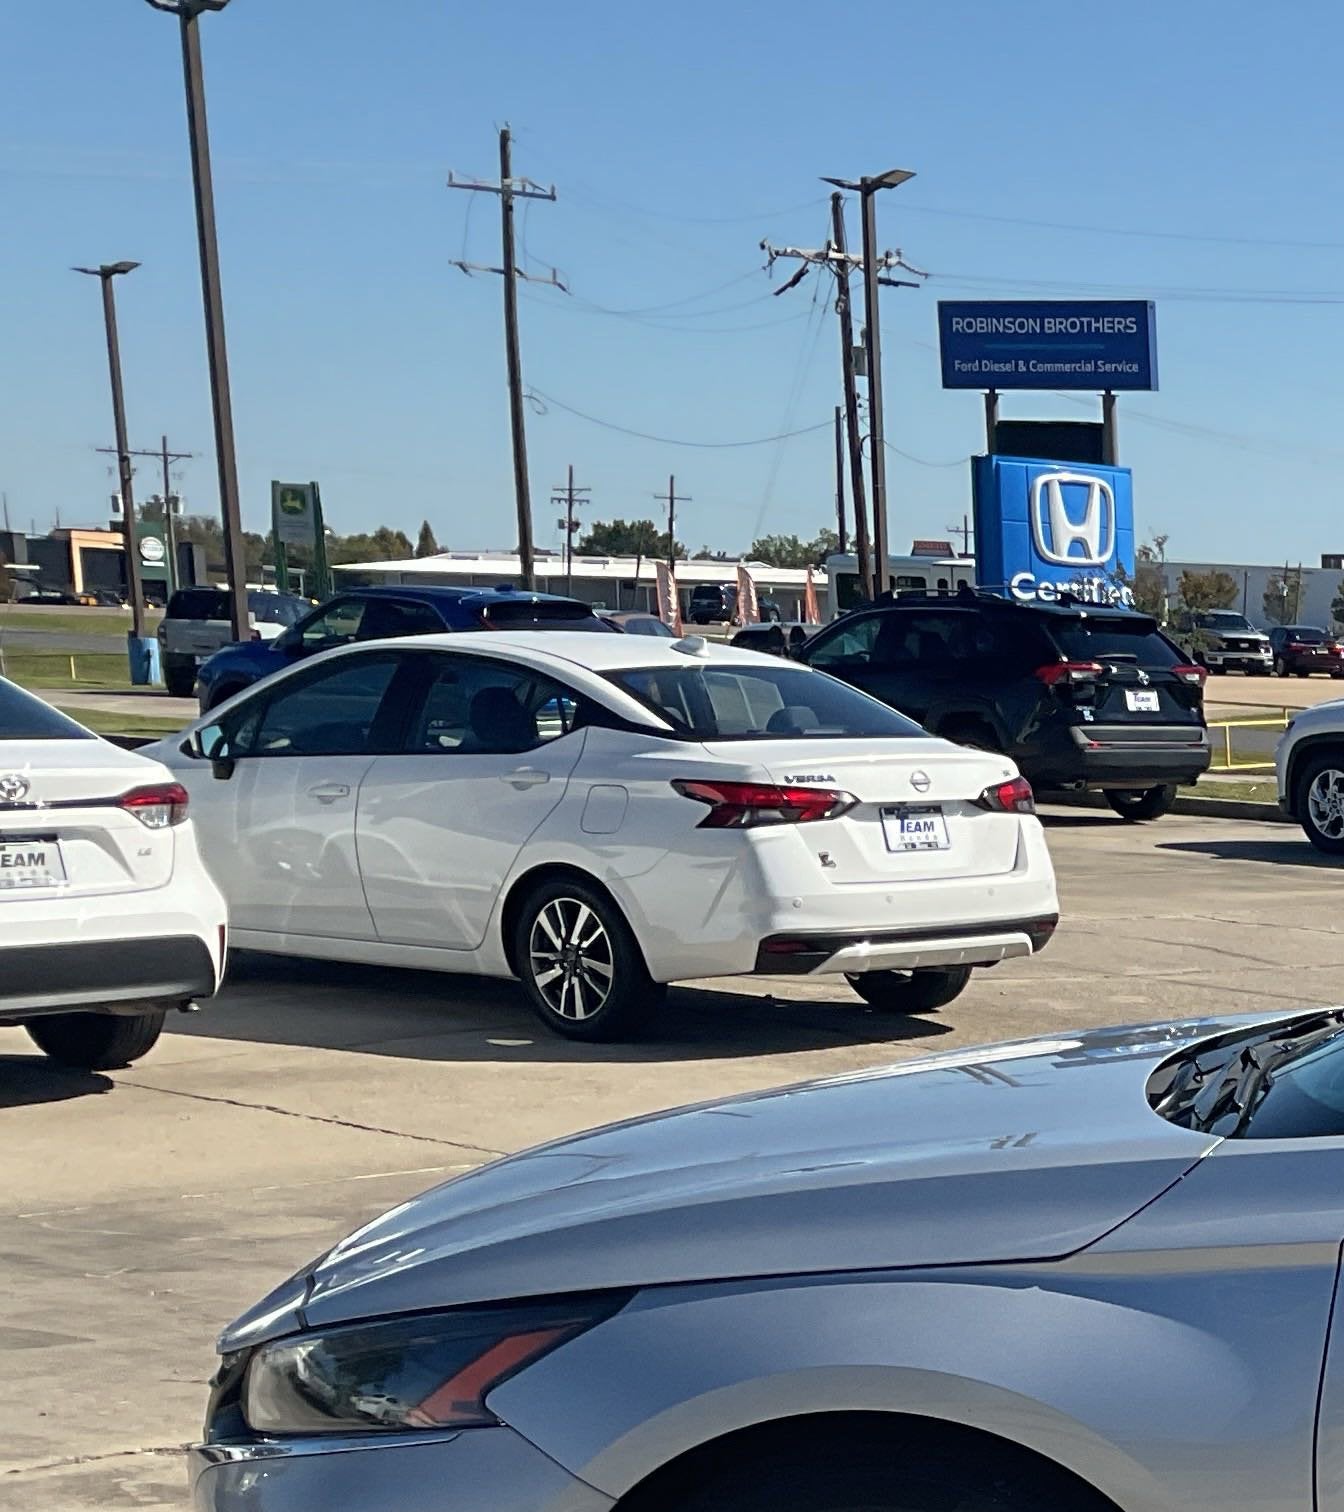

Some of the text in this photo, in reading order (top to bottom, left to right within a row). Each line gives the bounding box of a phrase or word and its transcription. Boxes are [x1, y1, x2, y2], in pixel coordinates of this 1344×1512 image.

[952, 317, 1137, 333] ROBINSON BROTHERS
[954, 360, 1139, 373] Ford Diesel & Commercial Service
[783, 774, 837, 784] VERSA
[896, 813, 935, 833] TEAM
[0, 851, 46, 868] EAM
